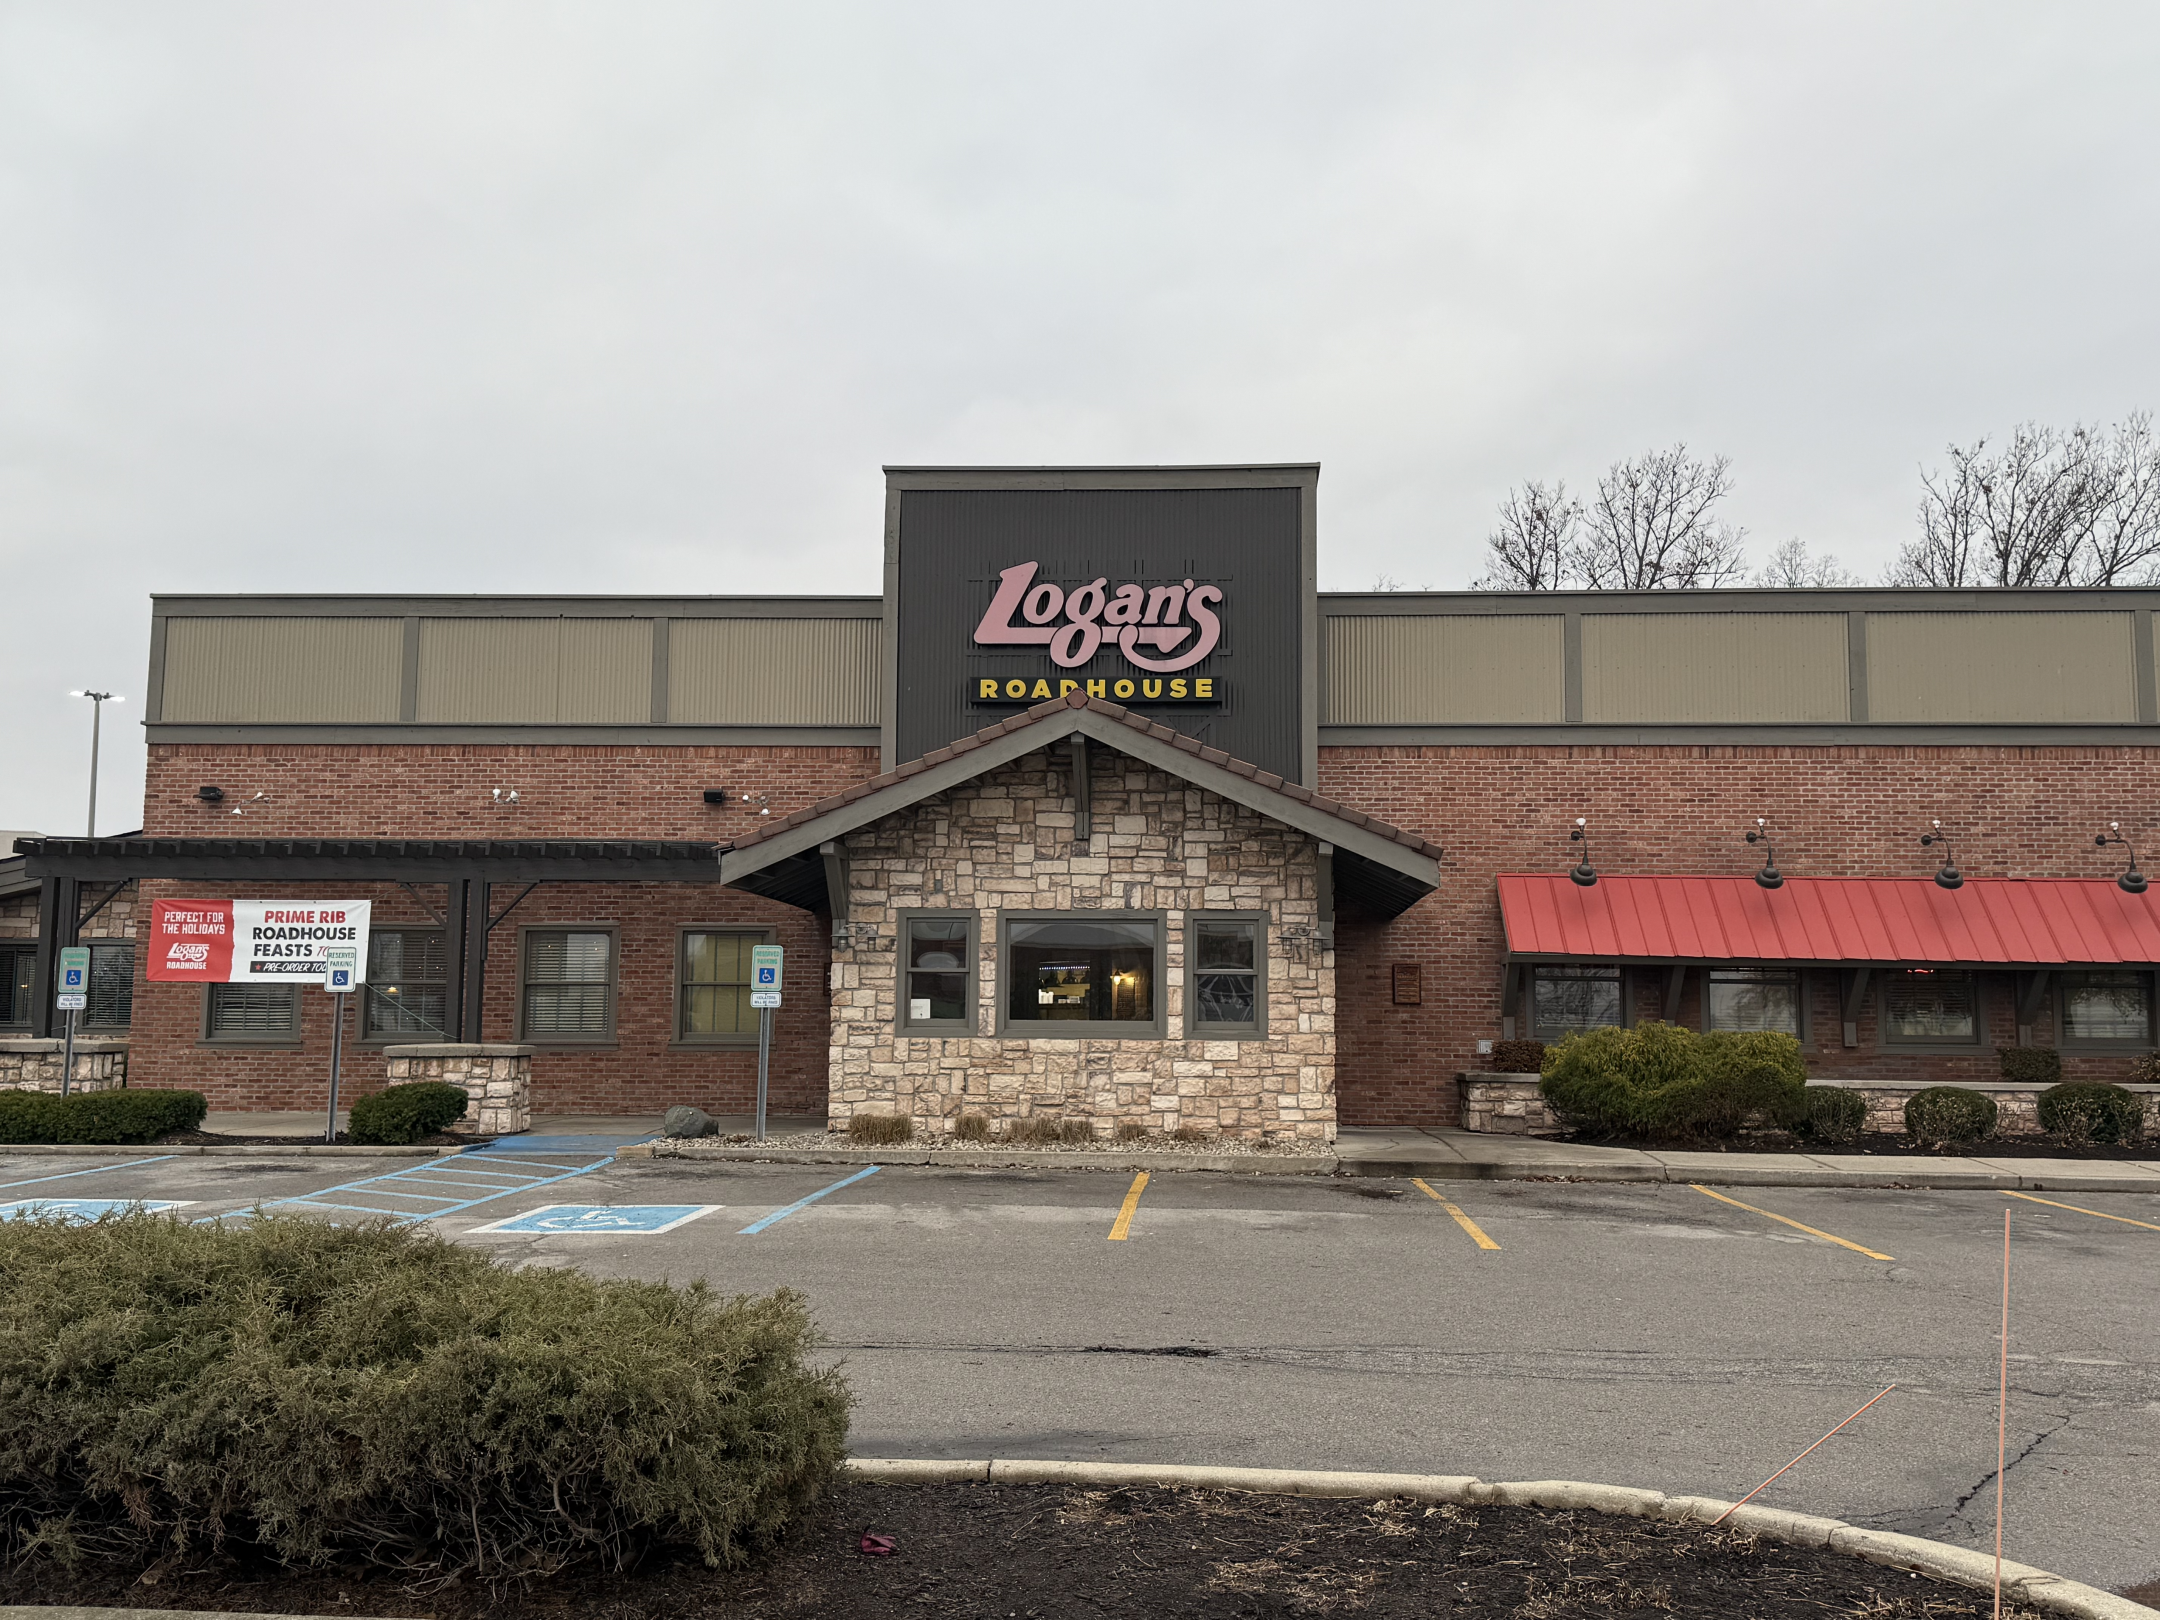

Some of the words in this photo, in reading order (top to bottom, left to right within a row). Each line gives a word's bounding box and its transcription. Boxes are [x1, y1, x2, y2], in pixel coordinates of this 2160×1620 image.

[973, 560, 1223, 673] Logan's
[979, 678, 1213, 699] ROADHOUSE
[164, 911, 204, 923] PERFECT
[207, 912, 224, 923] FOR
[264, 910, 315, 924] PRIME
[319, 910, 346, 924] RIB
[162, 923, 180, 934] THE
[181, 923, 226, 935] HOLIDAYS
[252, 926, 357, 941] ROADHOUSE
[253, 943, 313, 957] FEASTS
[166, 961, 207, 970] ROADHOUSE
[263, 962, 311, 972] PRE-ORDER
